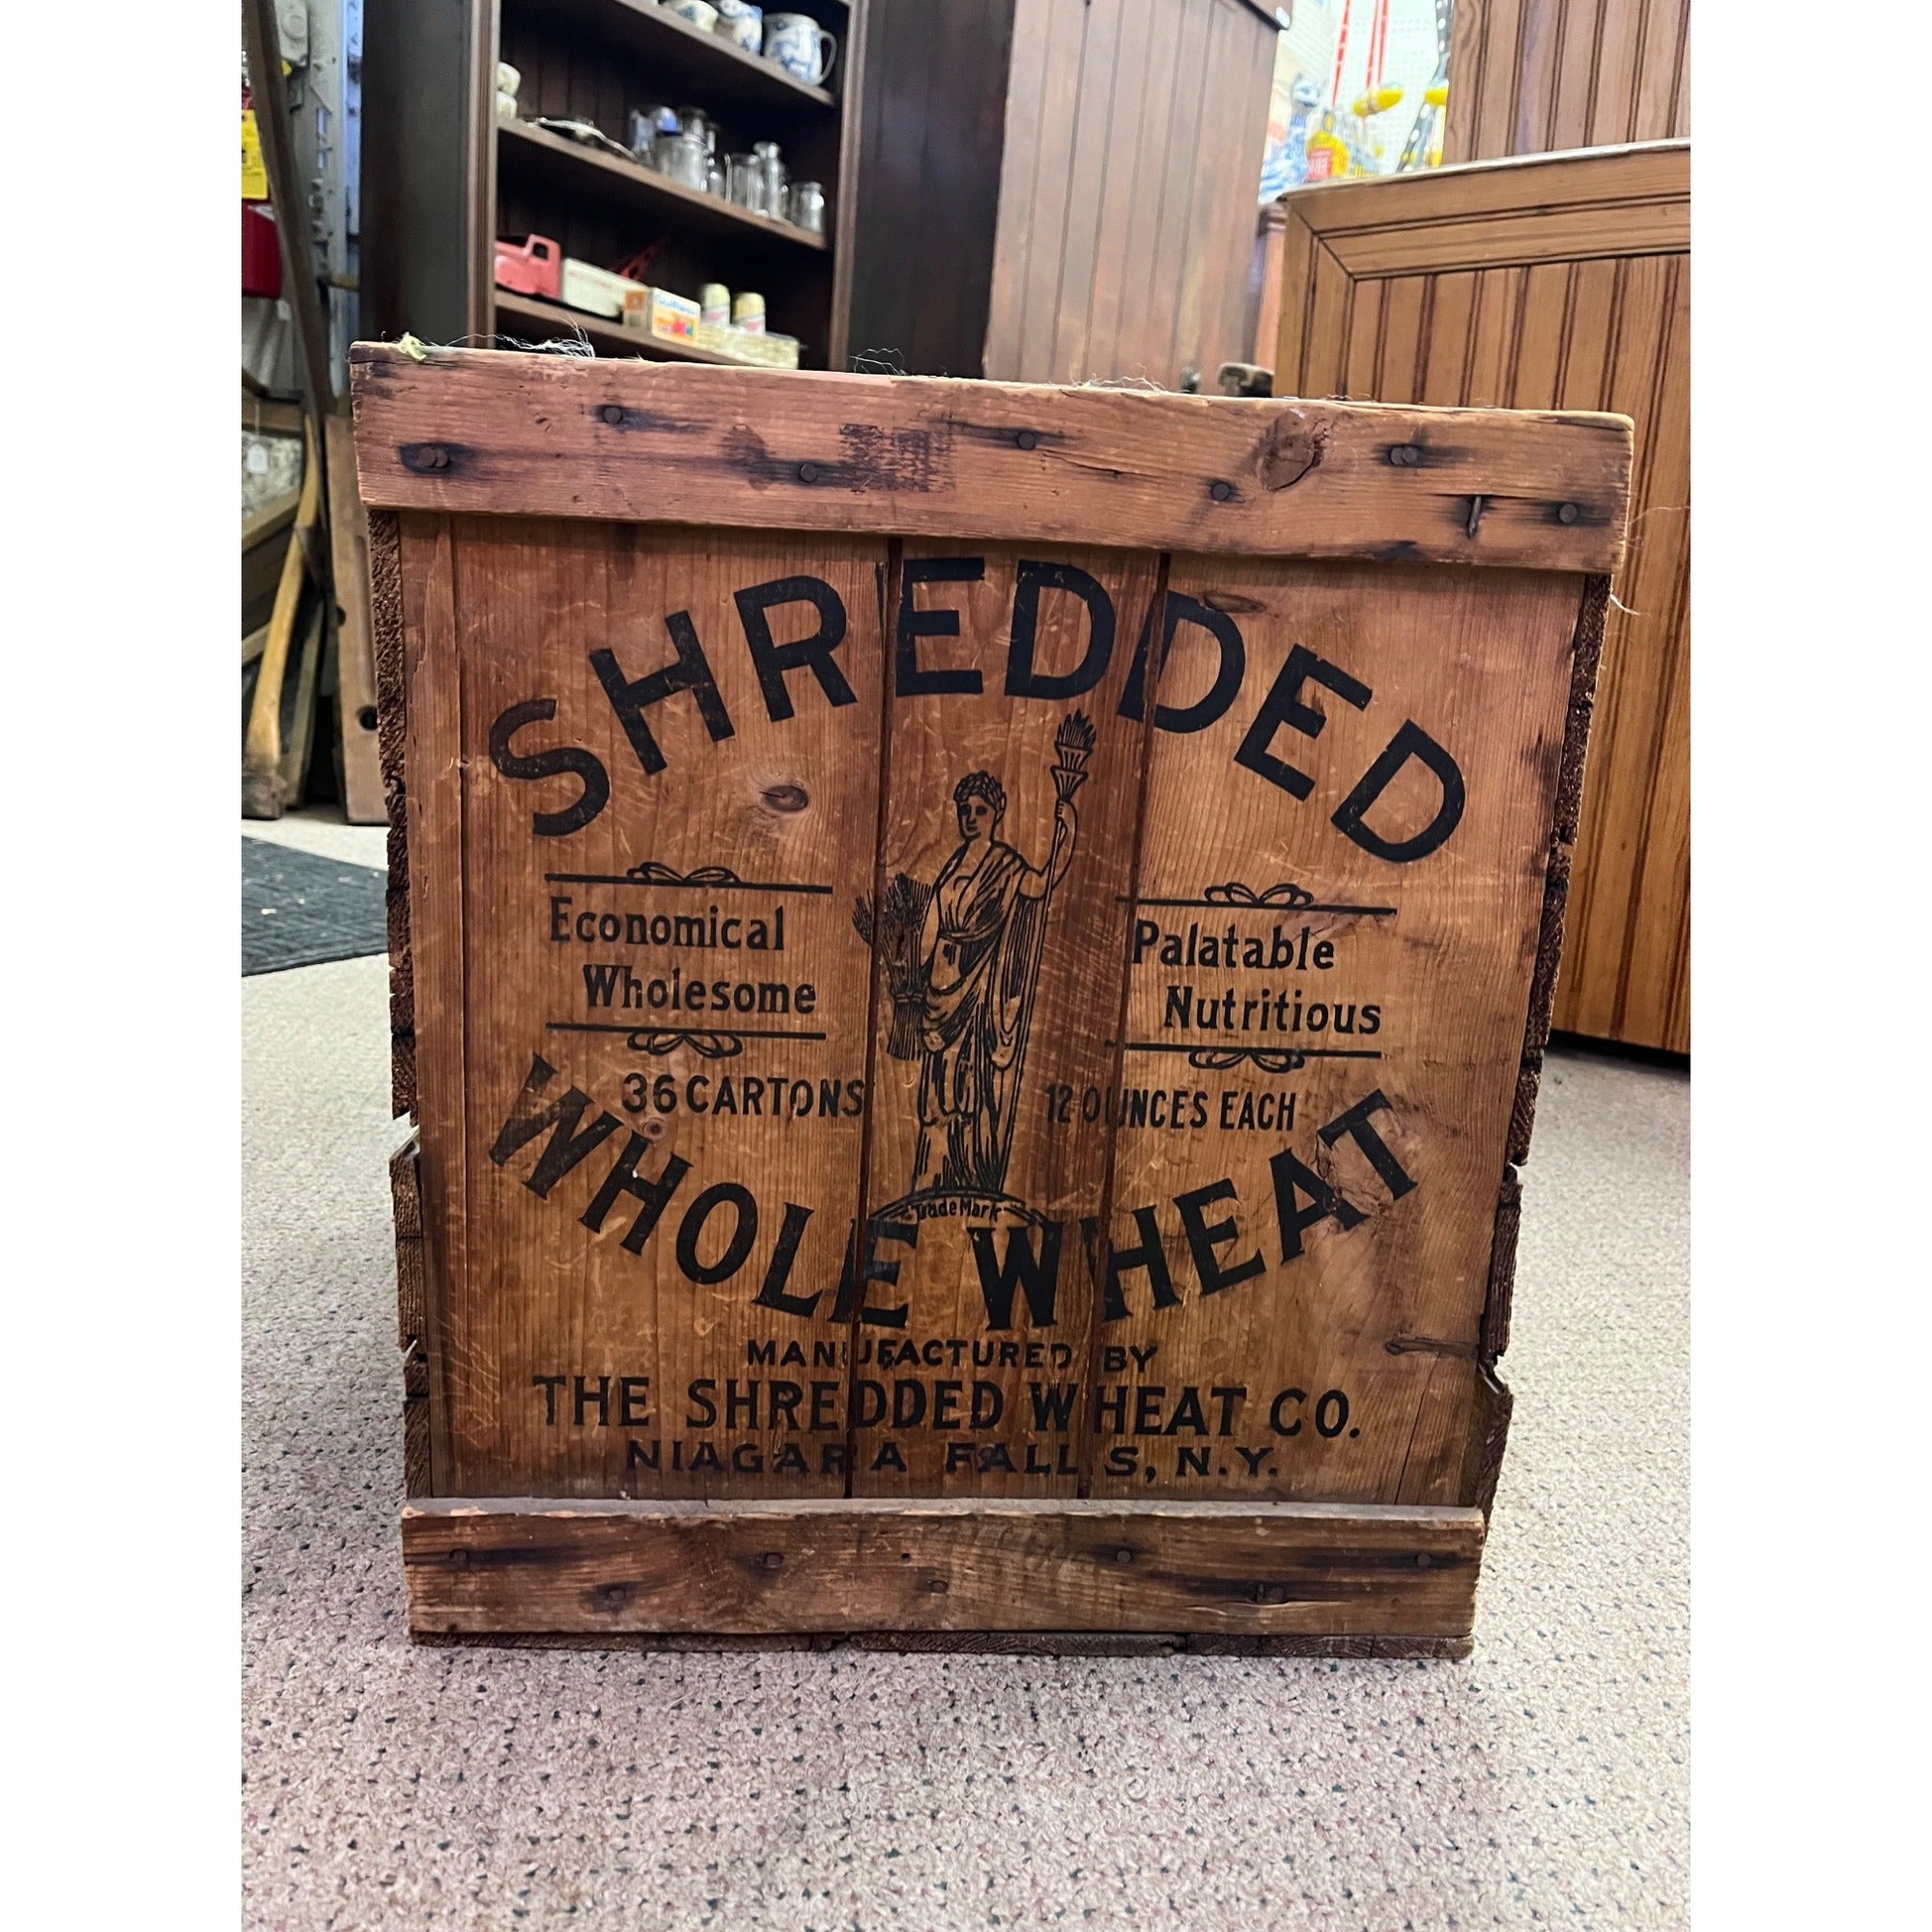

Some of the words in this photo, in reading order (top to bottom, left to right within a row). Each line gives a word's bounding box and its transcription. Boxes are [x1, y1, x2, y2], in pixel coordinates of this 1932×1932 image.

[487, 555, 1467, 864] SHREDDED
[549, 895, 785, 951] Economical
[1132, 918, 1335, 971] Palatable
[582, 963, 817, 1014] Wholesome
[1163, 984, 1382, 1036] Nutritious
[621, 1071, 677, 1113] 36
[685, 1073, 866, 1118] CARTONS
[1046, 1082, 1074, 1124] 12
[1081, 1086, 1208, 1129] OUNCES
[1219, 1090, 1297, 1132] EACH
[488, 1049, 919, 1329] WHOLE
[966, 1088, 1418, 1330] WHEAT
[960, 1197, 1002, 1222] Mark
[747, 1338, 1072, 1370] MANUFACTURED
[1103, 1344, 1158, 1374] BY
[532, 1375, 651, 1428] THE
[686, 1378, 1005, 1432] SHREDDED
[1030, 1381, 1248, 1437] WHEAT
[1269, 1387, 1361, 1439] CO.
[628, 1438, 907, 1476] NIAGARA
[944, 1442, 1157, 1485] FALLS,
[1176, 1446, 1279, 1480] N.Y.
